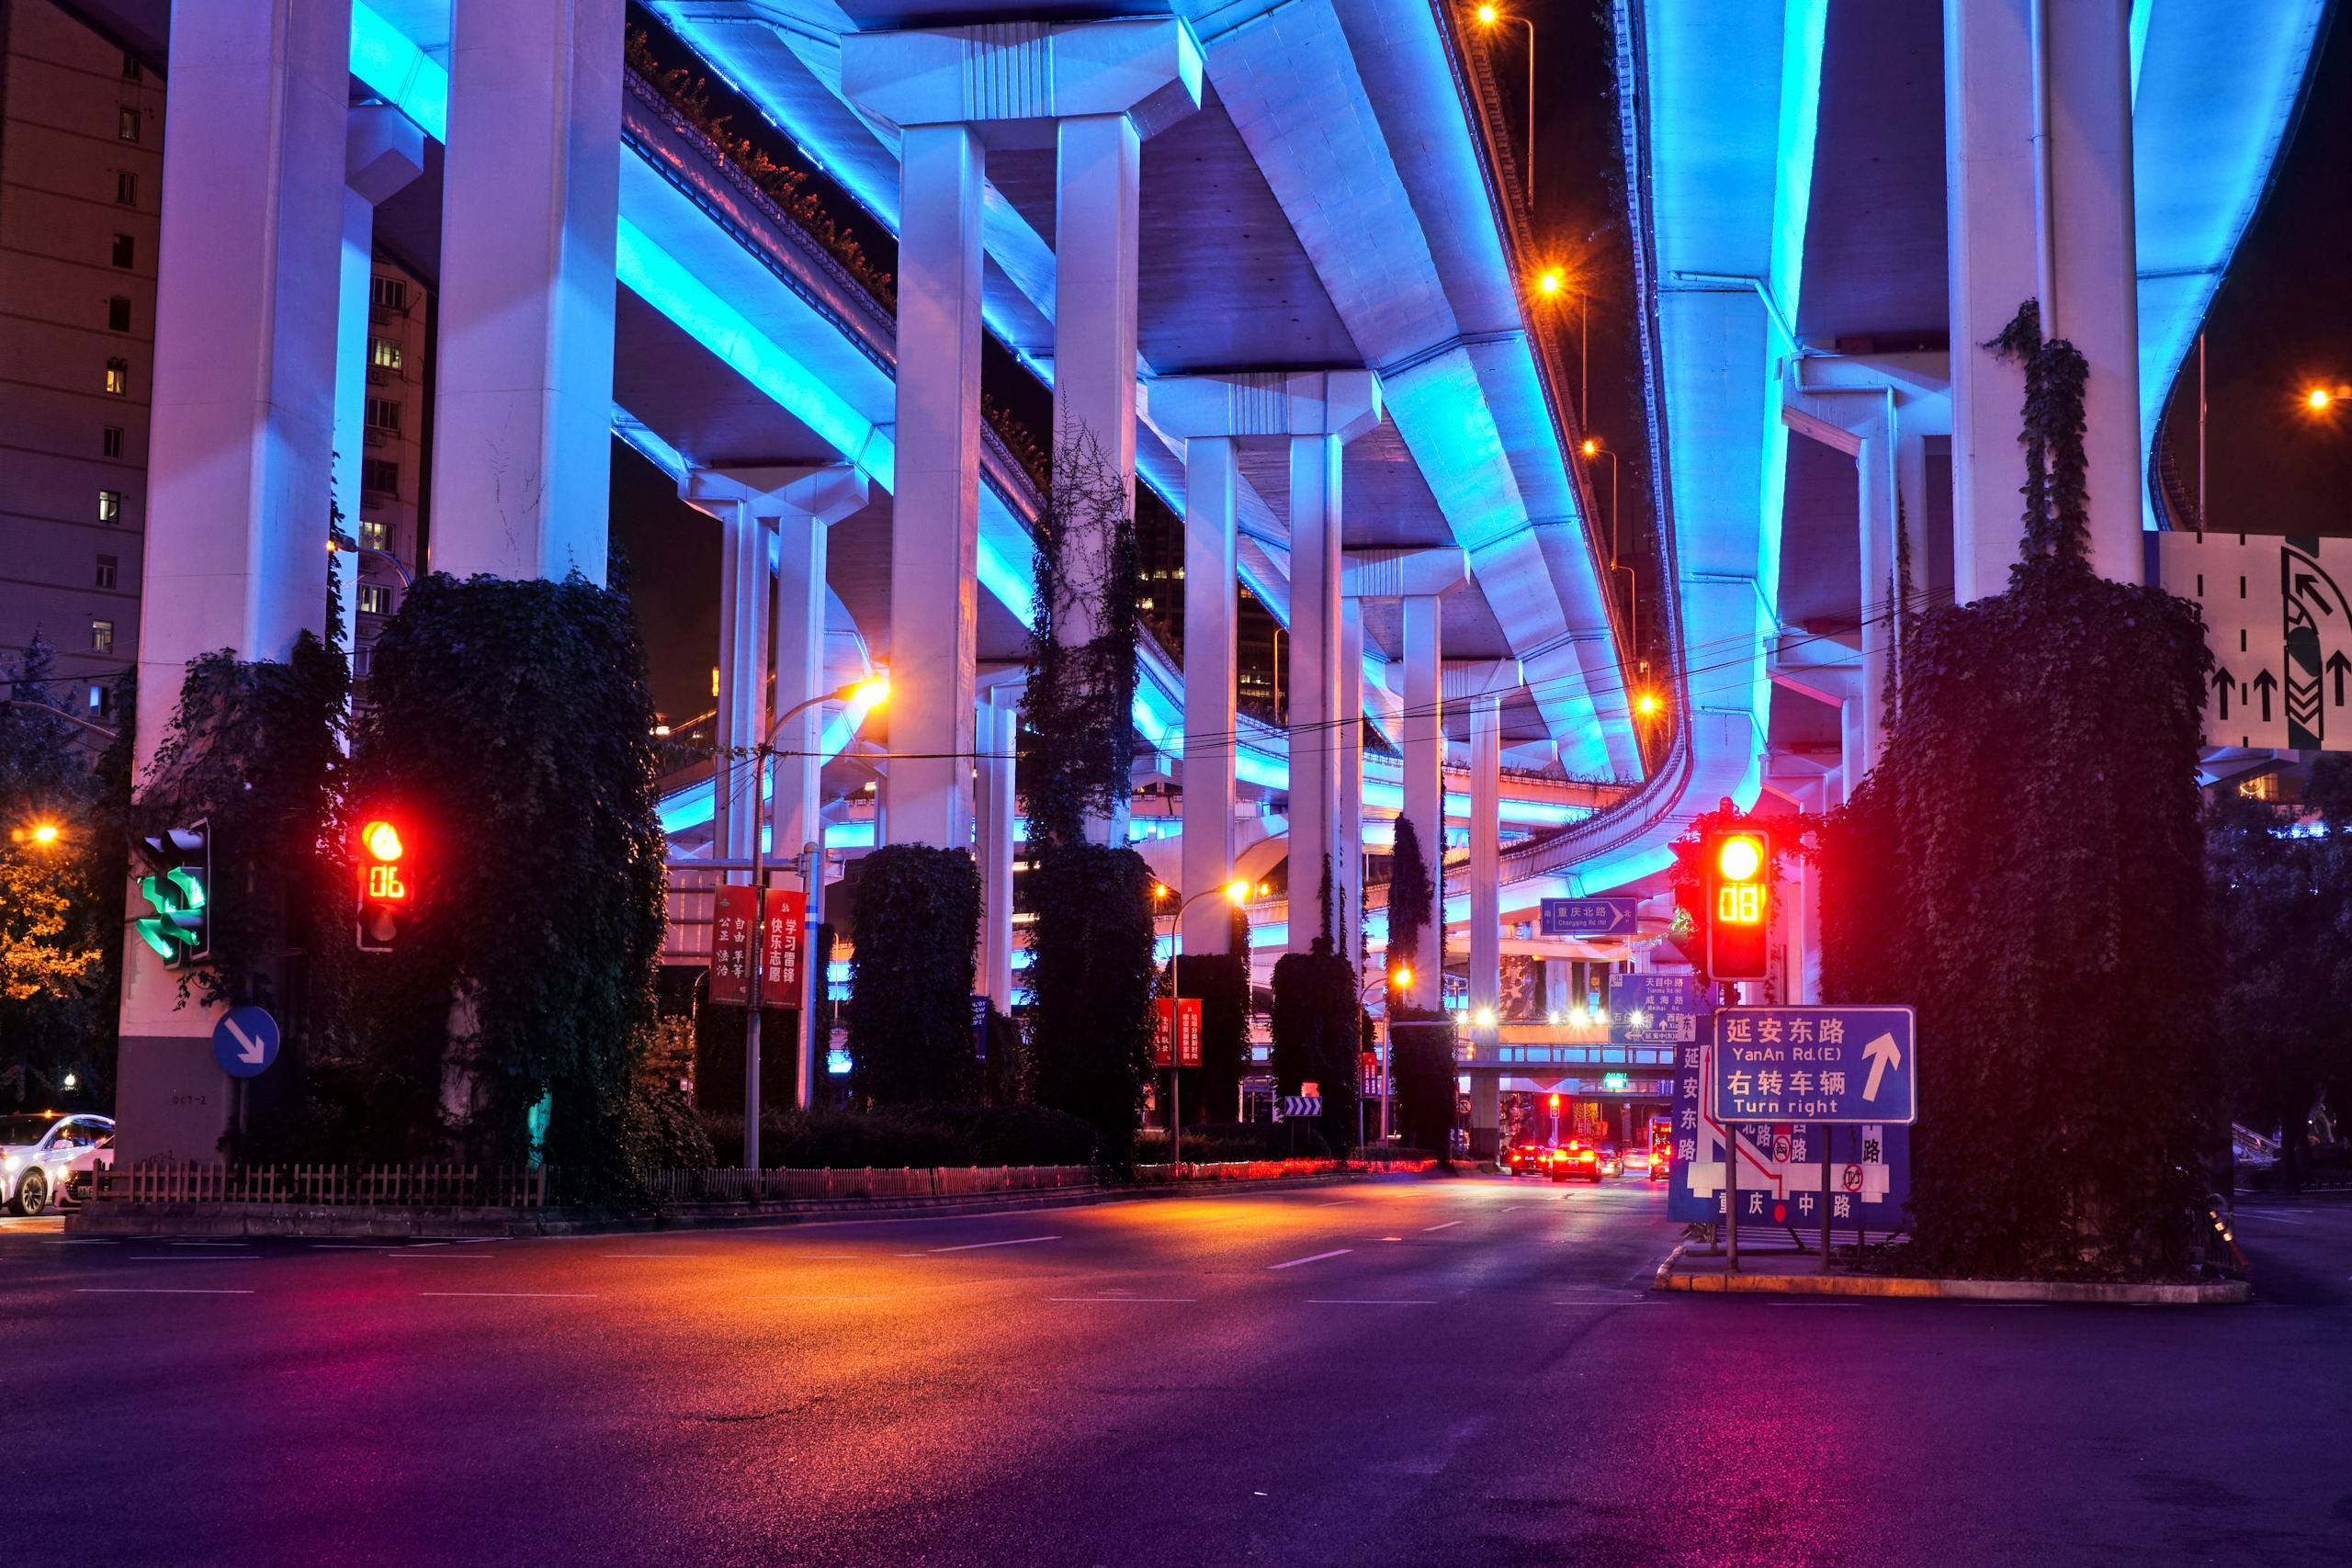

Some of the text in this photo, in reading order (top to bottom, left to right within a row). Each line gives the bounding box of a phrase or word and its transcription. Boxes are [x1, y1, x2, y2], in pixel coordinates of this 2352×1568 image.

[369, 864, 405, 898] 06
[1557, 907, 1607, 918] 重庆北路
[1719, 886, 1758, 922] 08
[719, 918, 731, 941] 公正
[734, 918, 745, 943] 自由
[717, 950, 729, 976] 法治
[769, 918, 782, 982] 快乐志愿
[784, 919, 797, 983] 学习雷锋
[731, 950, 744, 978] 平等
[1645, 977, 1684, 987] 天目中路
[1645, 995, 1684, 1005] 威海路
[1726, 1018, 1846, 1044] 延安东路
[1733, 1047, 1784, 1061] YanAn
[1726, 1070, 1846, 1097] 右转车辆
[1677, 1047, 1700, 1162] 延安东路
[1734, 1099, 1838, 1118] Turn right
